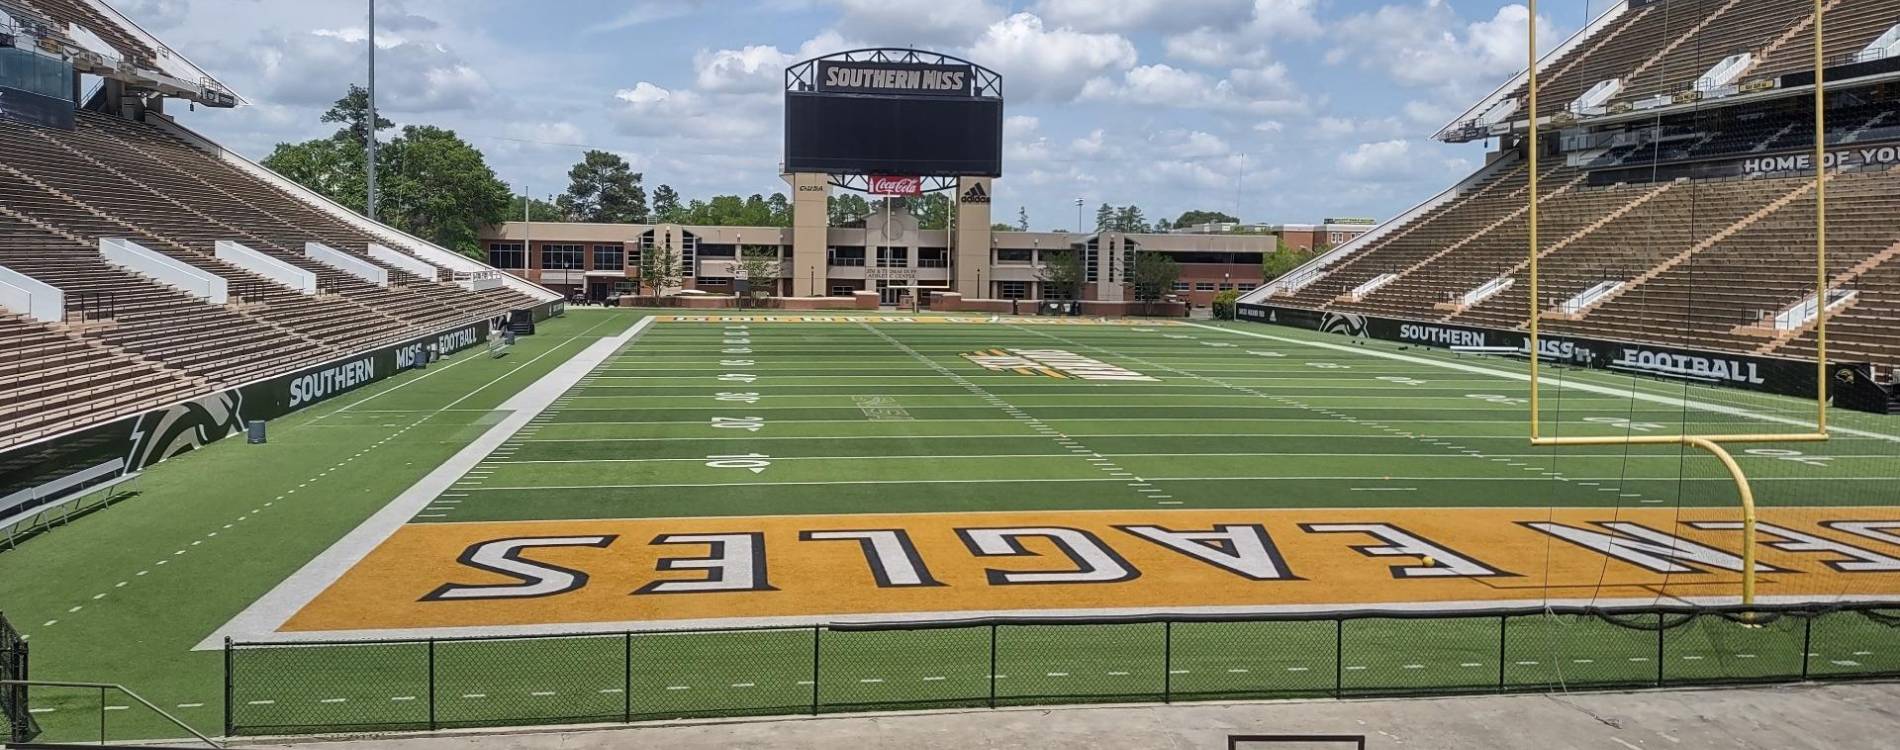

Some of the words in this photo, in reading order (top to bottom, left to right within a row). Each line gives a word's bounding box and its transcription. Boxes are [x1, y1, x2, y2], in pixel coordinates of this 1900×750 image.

[826, 66, 920, 89] SOUTHERN
[922, 69, 965, 90] MISS
[1744, 154, 1810, 173] HOME
[1824, 151, 1850, 168] OF
[1861, 146, 1900, 164] YO
[289, 356, 375, 408] SOUTHERN
[438, 326, 478, 354] FOOTBALL
[1400, 324, 1486, 347] SOUTHERN
[1623, 348, 1766, 384] FOOTBALL
[711, 416, 765, 428] 20
[705, 453, 772, 468] 10
[416, 521, 1527, 603] EAGLES
